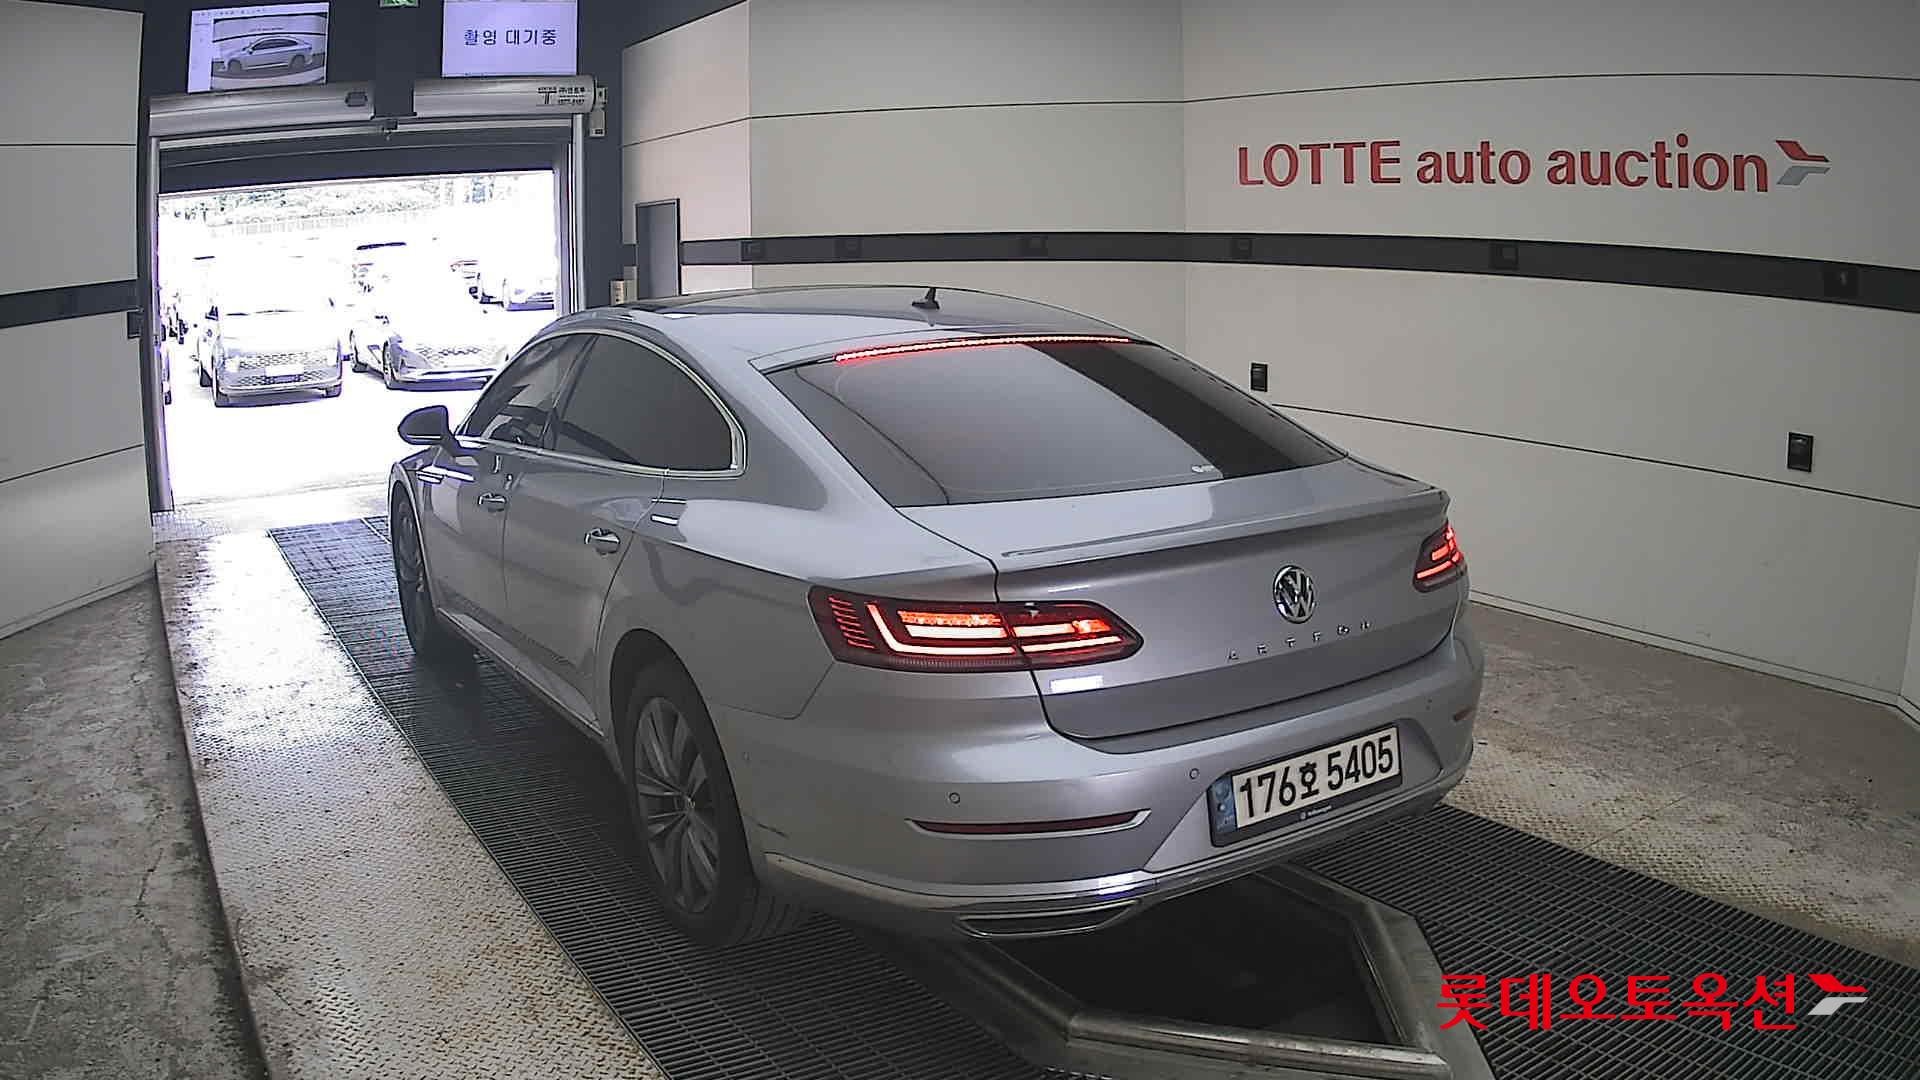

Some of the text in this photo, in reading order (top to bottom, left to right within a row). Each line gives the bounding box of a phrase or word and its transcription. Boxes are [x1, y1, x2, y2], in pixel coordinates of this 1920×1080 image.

[505, 29, 558, 46] 대기중
[1238, 133, 1769, 192] LOTTE auto auction
[1240, 735, 1393, 818] 176호 5405
